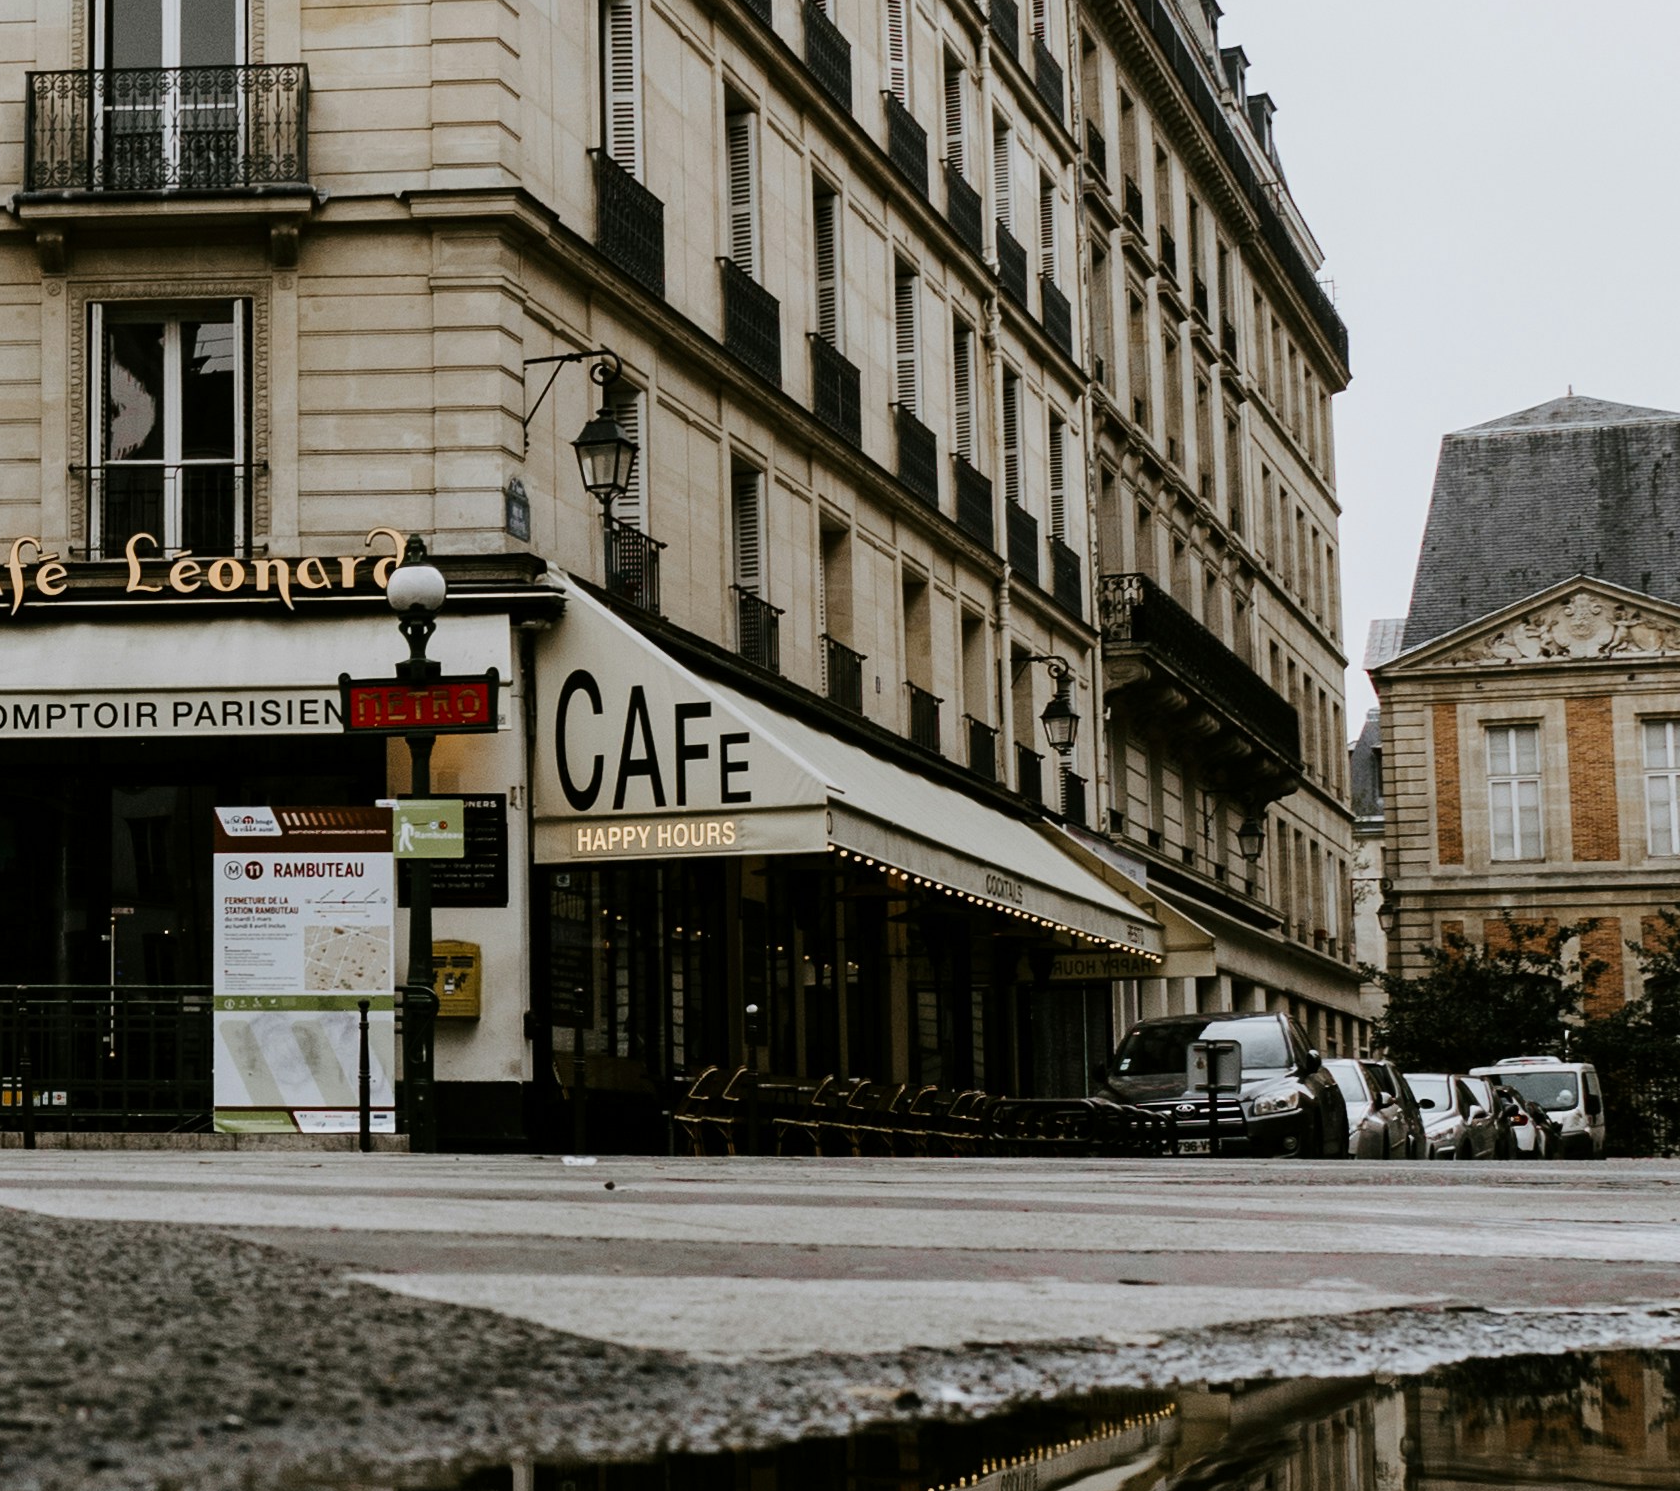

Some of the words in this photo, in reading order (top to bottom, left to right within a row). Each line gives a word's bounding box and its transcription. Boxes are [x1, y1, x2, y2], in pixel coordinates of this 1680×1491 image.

[125, 526, 408, 610] Léonard
[172, 698, 343, 729] PARISIEN
[357, 688, 481, 722] METRO
[555, 669, 753, 813] CAFE
[576, 825, 651, 853] HAPPY
[656, 820, 737, 849] HOURS
[273, 861, 365, 879] RAMBUTEAU
[224, 896, 266, 905] FERMETURE
[268, 896, 277, 905] DE
[279, 896, 288, 905] LA
[224, 907, 253, 915] STATION
[255, 907, 299, 915] RAMBUTEAU
